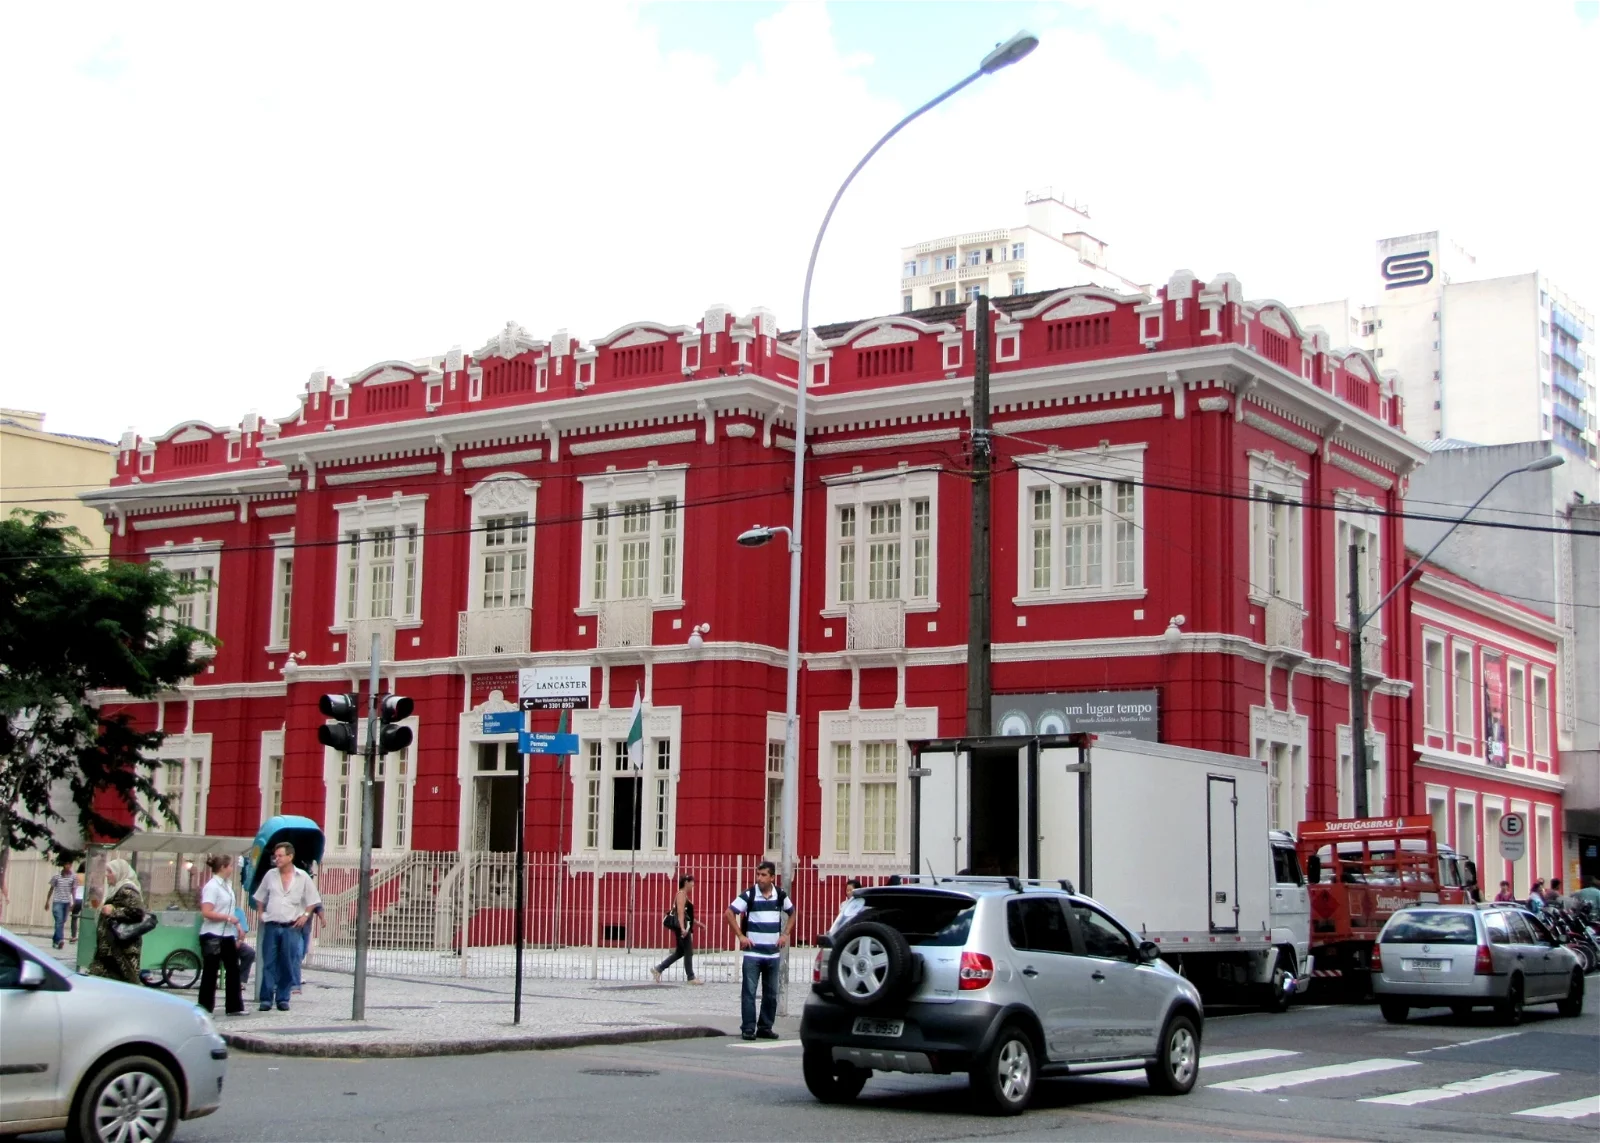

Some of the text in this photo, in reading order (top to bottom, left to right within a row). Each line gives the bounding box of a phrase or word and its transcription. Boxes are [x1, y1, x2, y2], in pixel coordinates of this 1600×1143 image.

[536, 681, 587, 690] LANCASTER
[1065, 702, 1152, 717] um lugar tempo
[1325, 820, 1394, 831] SUPERGASBRAS
[1507, 817, 1517, 832] E
